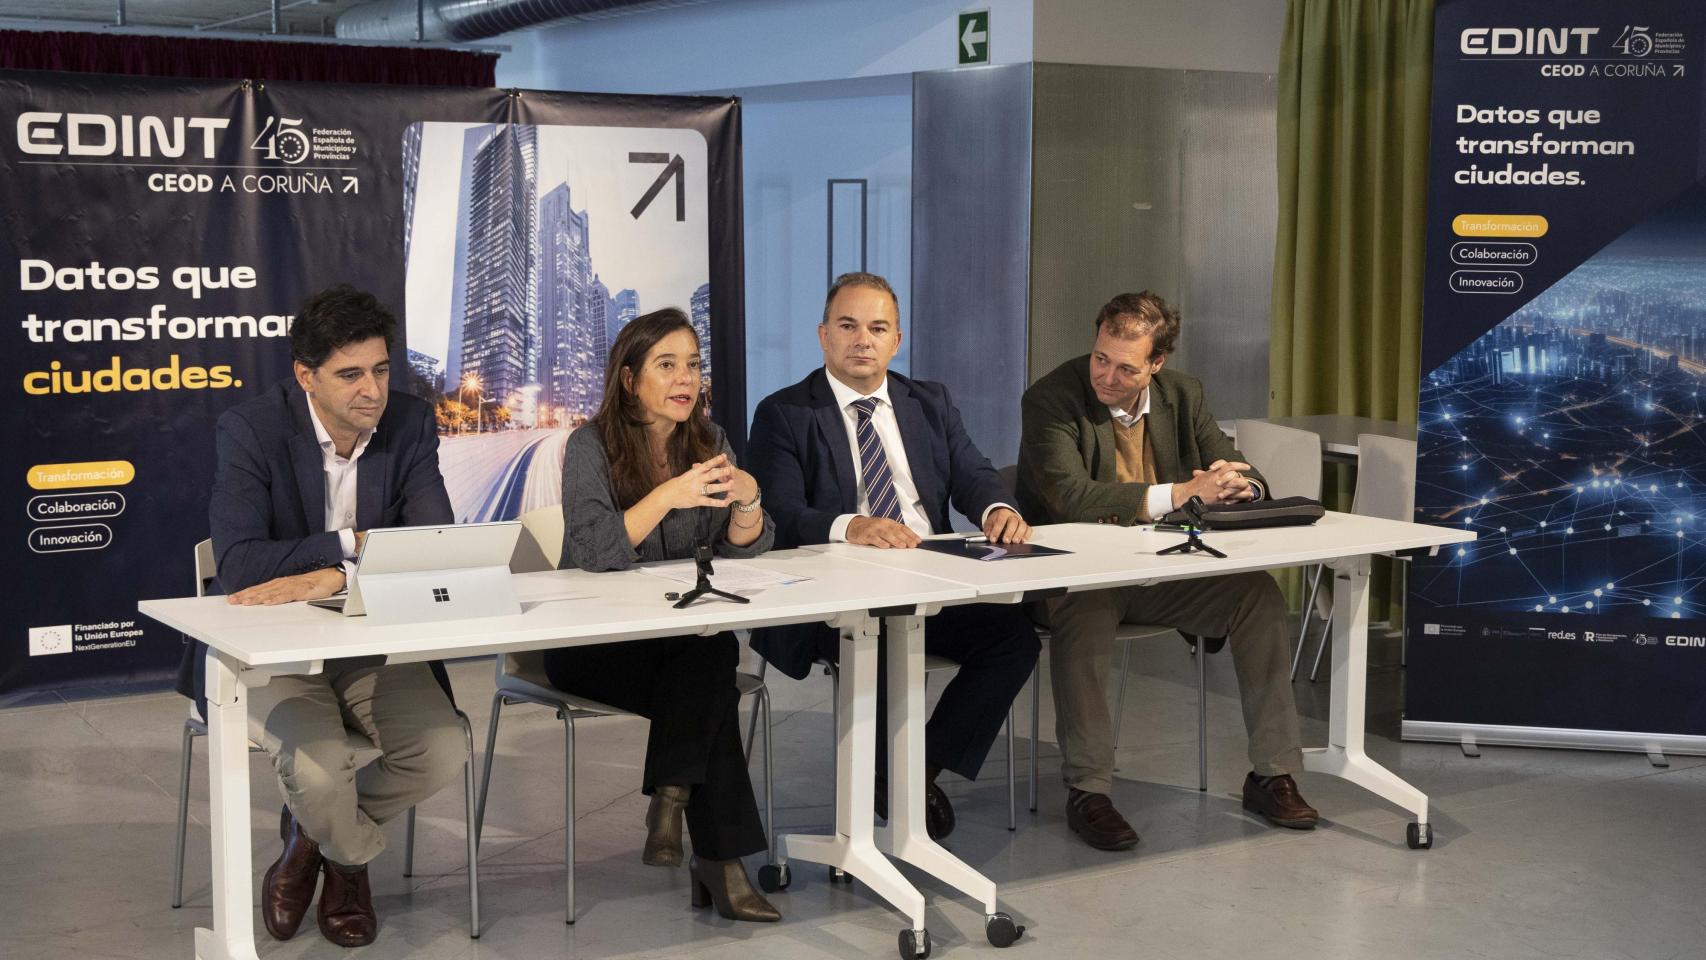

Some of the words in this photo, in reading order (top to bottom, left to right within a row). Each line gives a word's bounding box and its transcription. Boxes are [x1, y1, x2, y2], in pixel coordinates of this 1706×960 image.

[1460, 27, 1600, 55] EDINT
[1612, 24, 1653, 57] 45
[1541, 64, 1585, 77] CEOD
[1589, 65, 1600, 77] A
[1604, 62, 1666, 77] CORUÑA
[1456, 104, 1540, 124] Datos
[1548, 109, 1601, 130] que
[17, 112, 231, 159] EDINT
[312, 128, 352, 136] Federación
[250, 115, 310, 165] 45
[313, 136, 344, 145] Española
[1456, 132, 1635, 155] transforman
[313, 144, 351, 152] Municipios
[351, 146, 357, 154] y
[1454, 163, 1586, 186] ciudades.
[148, 173, 213, 193] CEOD
[220, 175, 236, 193] A
[242, 172, 333, 194] CORUÑA
[1461, 220, 1539, 231] Transformación
[1459, 248, 1529, 260] Colaboración
[20, 259, 160, 291] Datos
[172, 265, 257, 299] que
[1459, 277, 1514, 288] Innovación
[22, 304, 296, 343] transforma
[23, 354, 243, 395] ciudades.
[37, 470, 125, 483] Transformación
[37, 499, 116, 514] Colaboración
[39, 530, 103, 546] Innovación
[75, 622, 119, 631] Financiado
[121, 621, 134, 629] por
[84, 632, 109, 641] Unión
[110, 629, 143, 638] Europea
[1547, 630, 1576, 640] red.es
[75, 640, 136, 651] NextGenerationEU
